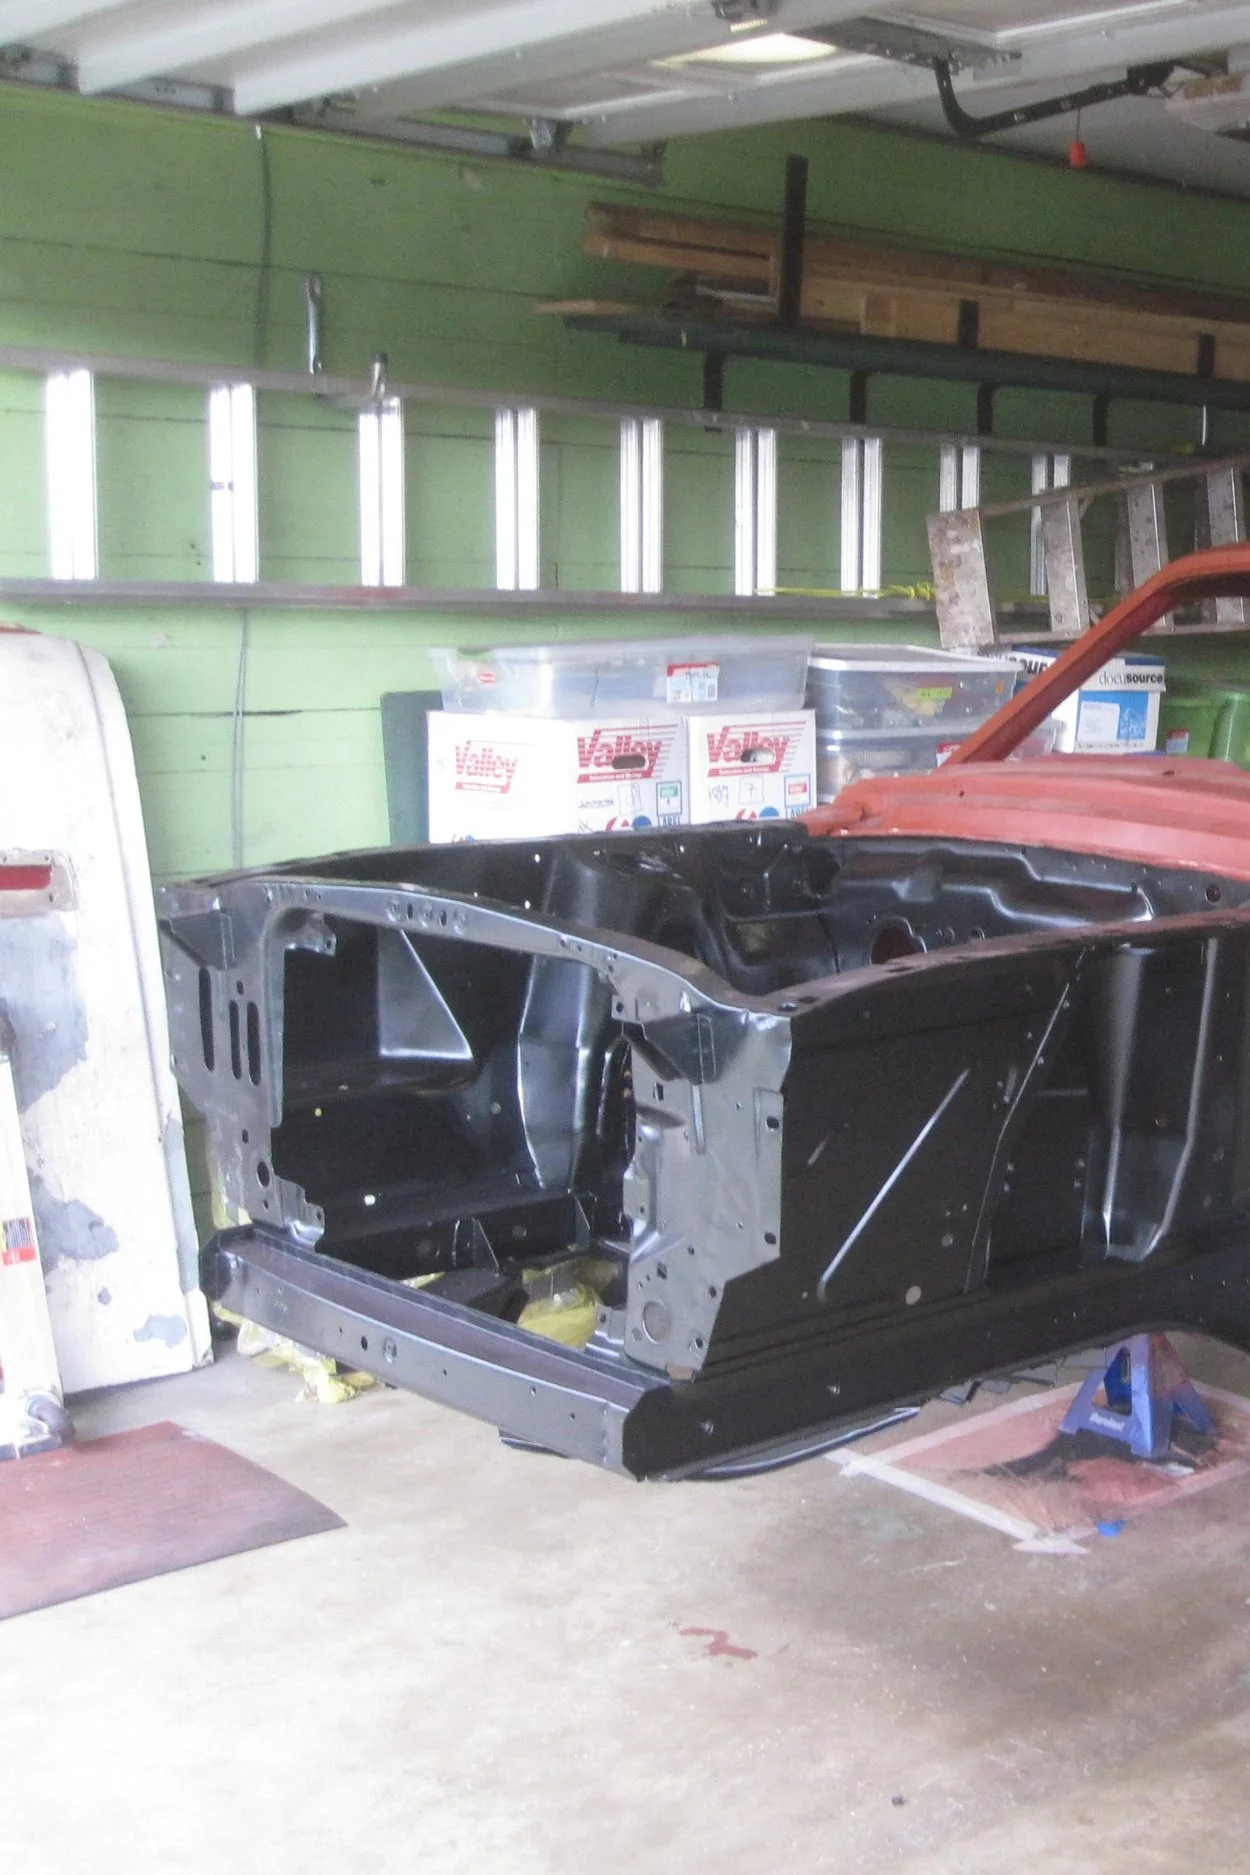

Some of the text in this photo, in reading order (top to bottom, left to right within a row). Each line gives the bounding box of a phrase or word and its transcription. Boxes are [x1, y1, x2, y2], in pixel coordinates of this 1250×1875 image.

[1099, 671, 1164, 686] docusource
[455, 740, 518, 793] Valley
[576, 729, 663, 778] Valley
[707, 726, 790, 772] Valley
